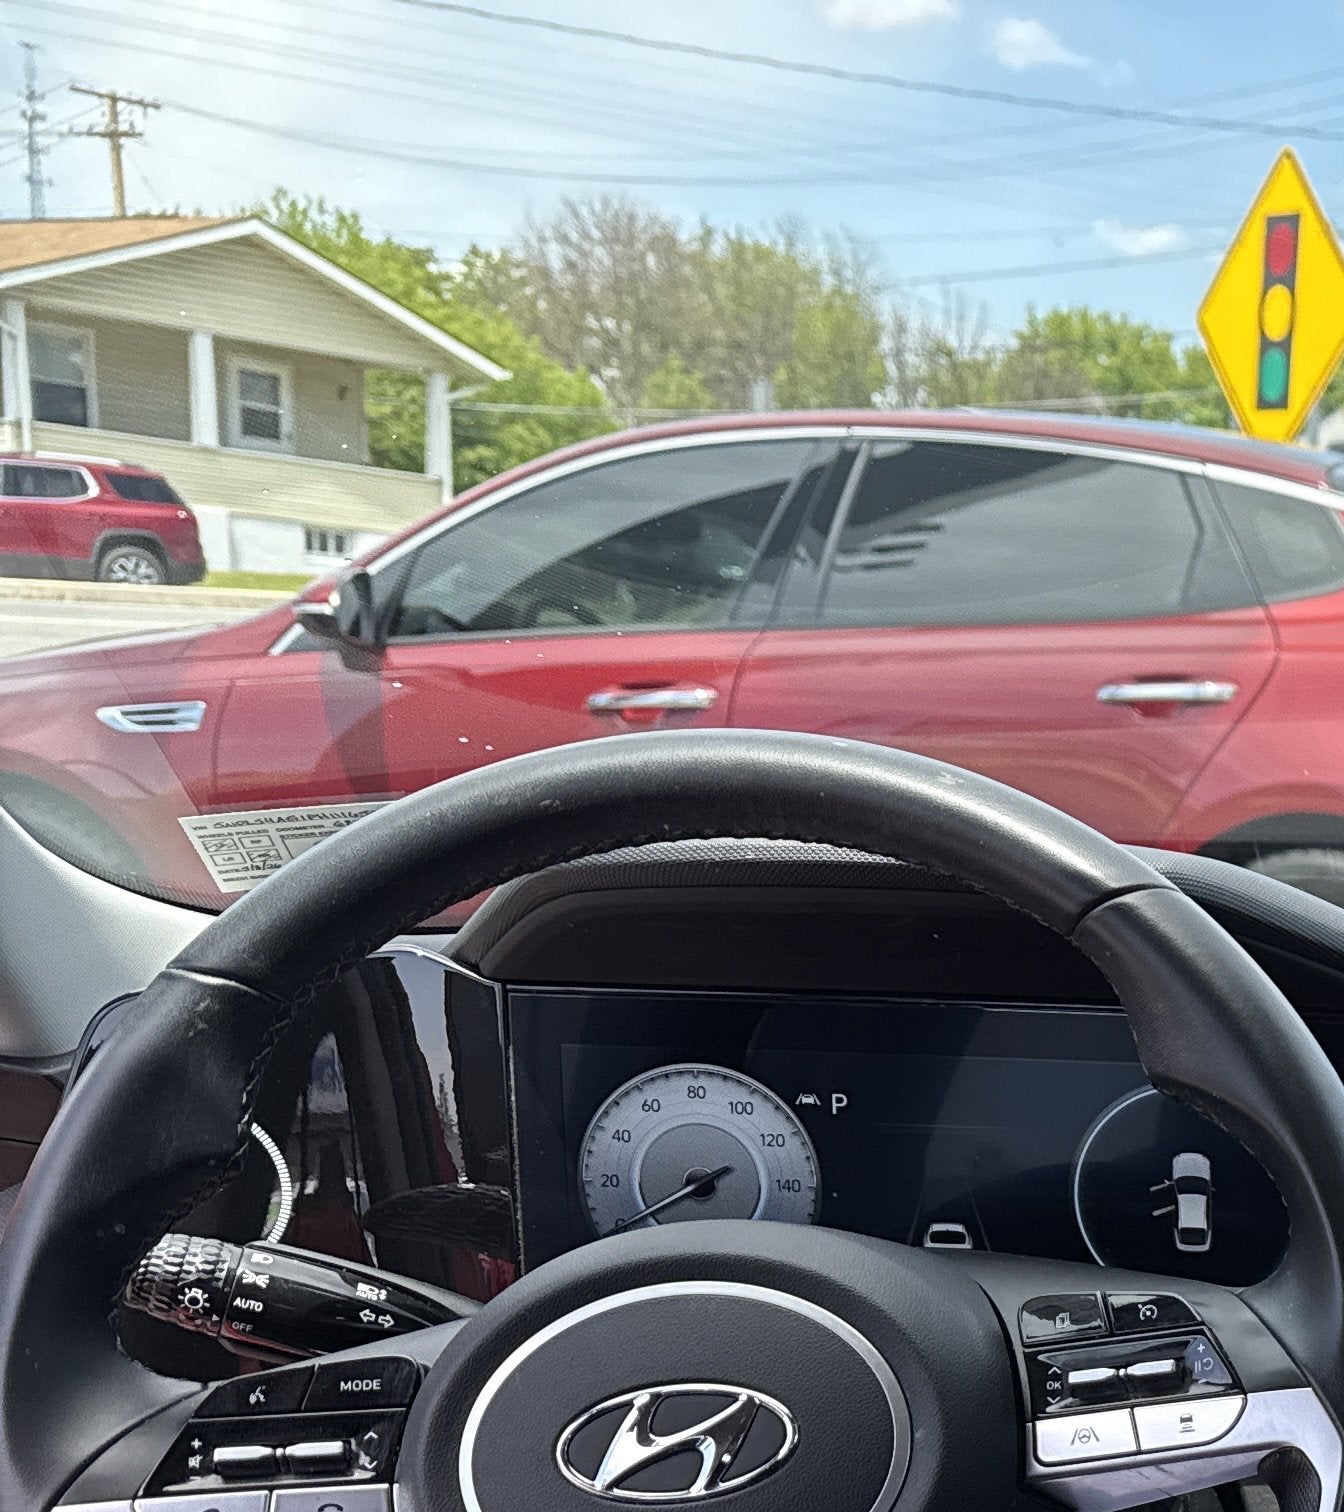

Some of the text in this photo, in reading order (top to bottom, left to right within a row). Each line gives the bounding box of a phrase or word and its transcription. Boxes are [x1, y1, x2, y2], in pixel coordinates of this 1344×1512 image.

[687, 1085, 706, 1099] 80
[642, 1099, 661, 1113] 60
[728, 1101, 754, 1116] 100
[831, 1093, 848, 1115] P
[611, 1129, 631, 1143] 40
[759, 1133, 785, 1148] 120
[601, 1174, 620, 1188] 20
[775, 1179, 801, 1193] 140
[233, 1296, 264, 1313] AUTO
[231, 1321, 254, 1333] OFF
[340, 1379, 382, 1392] MODE
[1046, 1381, 1062, 1391] OK
